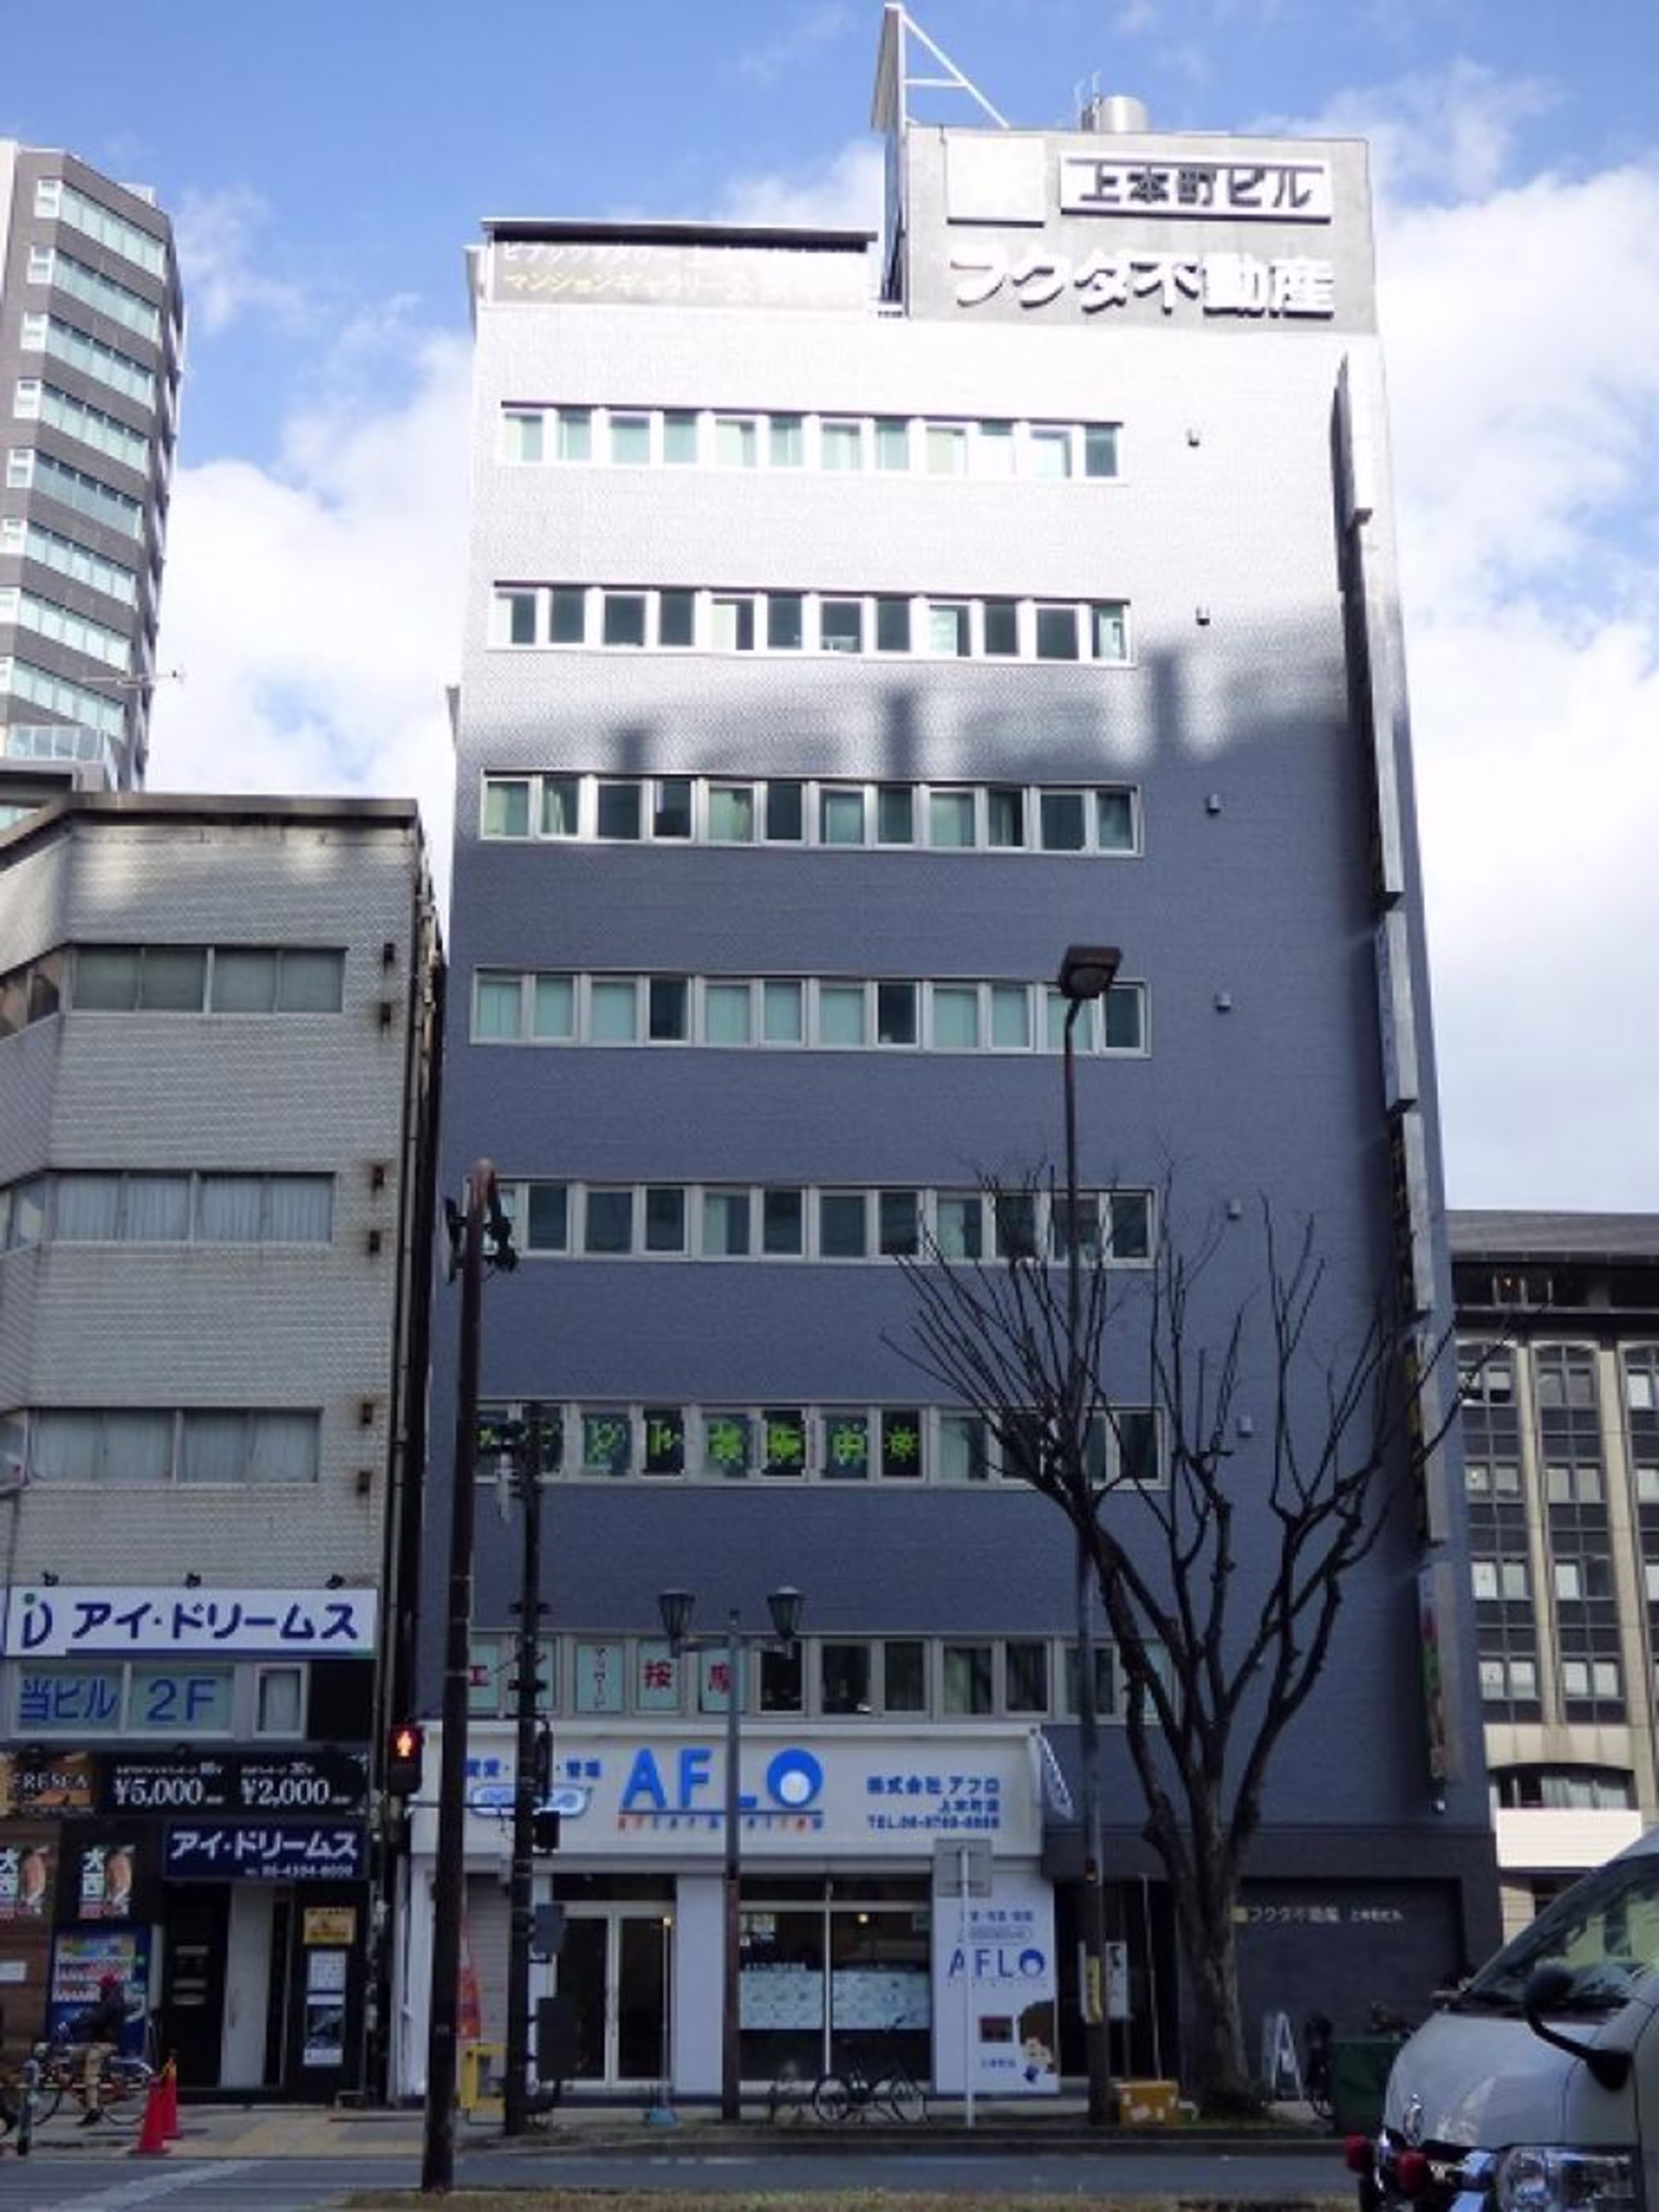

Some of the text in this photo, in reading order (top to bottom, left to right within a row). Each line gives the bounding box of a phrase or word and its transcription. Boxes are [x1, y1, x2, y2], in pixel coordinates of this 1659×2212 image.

[1080, 164, 1313, 209] 上本町ビル
[950, 251, 1335, 320] フクダ不動産
[72, 1602, 359, 1640] アイ・ドリームス
[19, 1677, 217, 1723] 当ビル 2F
[114, 1778, 203, 1806] ¥5,000
[241, 1778, 330, 1806] ¥2,000
[170, 1830, 358, 1860] アイ・ドリームス
